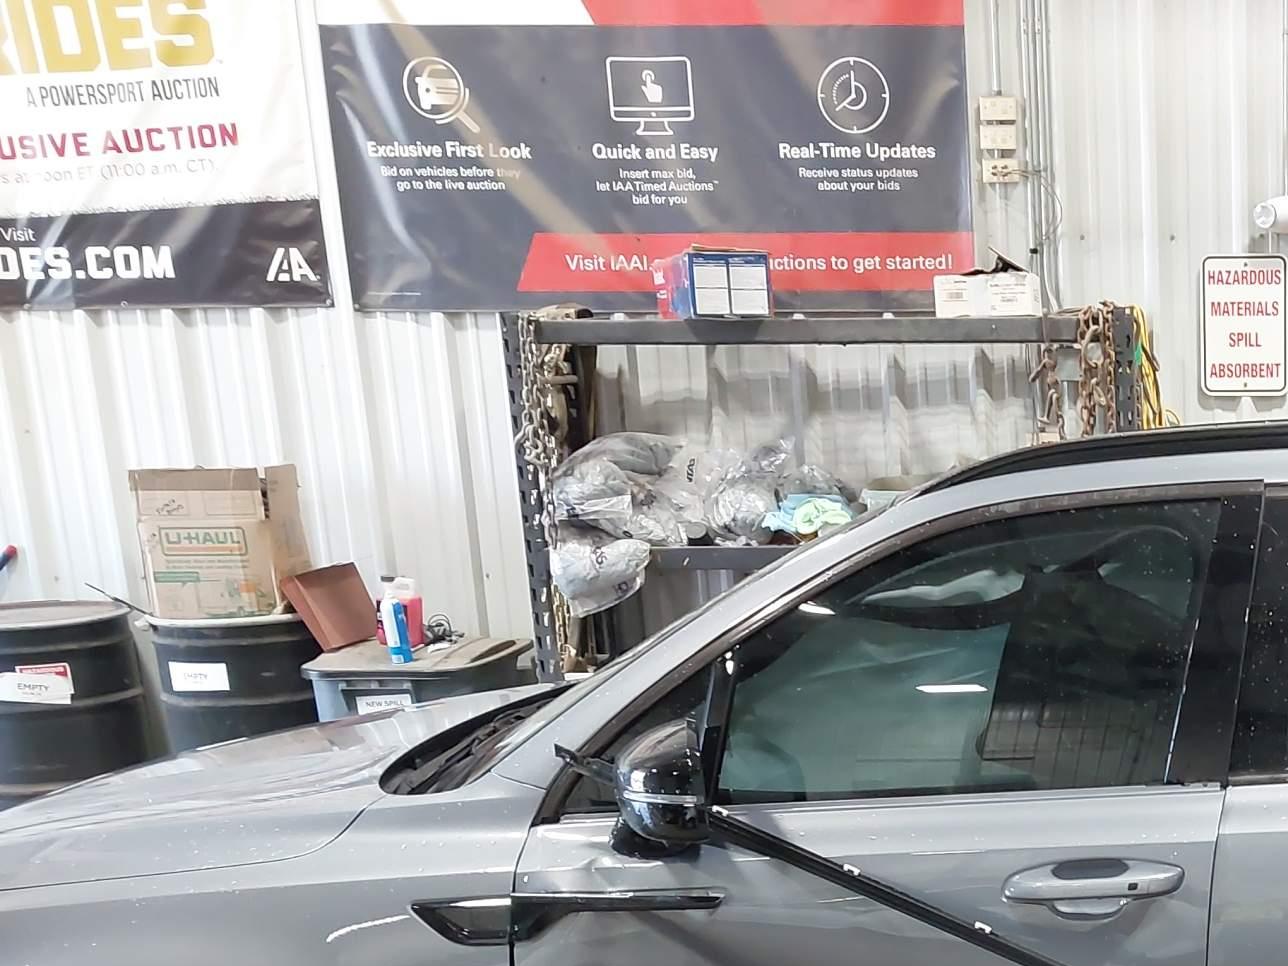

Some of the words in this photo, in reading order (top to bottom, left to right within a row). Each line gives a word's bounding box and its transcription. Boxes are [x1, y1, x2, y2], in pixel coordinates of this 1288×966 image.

[0, 0, 214, 75] IDES
[26, 87, 38, 107] A
[39, 81, 145, 107] POWERSPORT
[151, 77, 220, 101] AUCTION
[102, 123, 239, 154] AUCTION
[367, 141, 443, 158] Exclusive
[445, 141, 484, 158] First
[489, 142, 532, 159] Look
[592, 143, 642, 160] Quick
[645, 144, 676, 159] and
[680, 143, 718, 162] Easy
[778, 143, 861, 159] Real-Time
[865, 143, 936, 161] Updates
[380, 165, 397, 177] Bid
[399, 168, 413, 177] on
[414, 165, 459, 177] vehicles
[460, 166, 494, 177] before
[496, 167, 520, 180] they
[619, 168, 649, 179] Insert
[651, 170, 674, 179] max
[676, 167, 696, 180] bid,
[798, 167, 839, 178] Receive
[841, 167, 873, 178] status
[876, 167, 919, 179] updates
[397, 181, 410, 192] go
[412, 179, 424, 190] to
[426, 179, 442, 190] the
[445, 179, 464, 190] live
[466, 180, 506, 191] auction
[596, 181, 610, 191] let
[612, 181, 634, 191] IAA
[634, 180, 667, 191] Timed
[818, 180, 848, 191] about
[849, 182, 875, 192] your
[877, 180, 900, 191] bids
[632, 194, 649, 205] bid
[651, 193, 666, 205] for
[668, 195, 688, 206] you
[0, 228, 36, 241] Visit
[0, 246, 176, 280] DES.COM
[565, 254, 606, 271] Visit
[830, 255, 848, 270] to
[853, 255, 881, 273] get
[886, 253, 952, 270] started!
[1208, 269, 1281, 285] HAZARDOUS
[1210, 301, 1279, 316] MATERIALS
[1229, 332, 1262, 348] SPILL
[1210, 363, 1281, 378] ABSORBENT
[165, 531, 241, 544] U-HAUL
[17, 682, 49, 692] EMPTY
